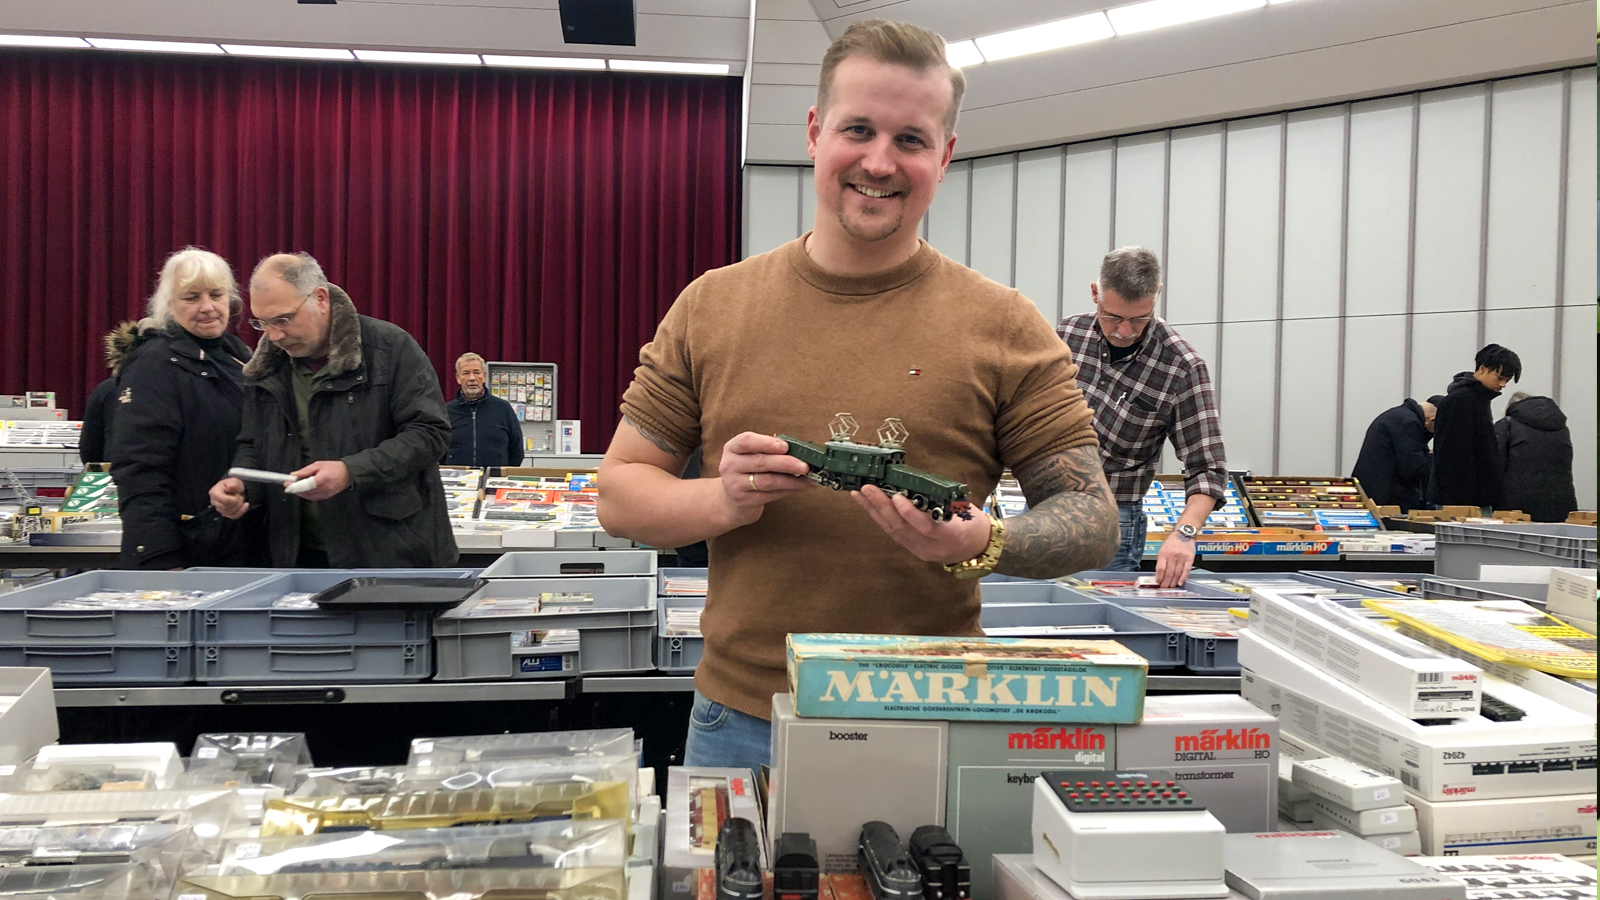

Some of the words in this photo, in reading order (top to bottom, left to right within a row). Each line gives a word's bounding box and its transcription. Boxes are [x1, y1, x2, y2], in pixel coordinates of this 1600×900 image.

[1197, 543, 1235, 552] märklin
[1276, 543, 1312, 551] märklin
[819, 669, 1122, 707] MÄRKLIN
[829, 731, 869, 741] booster
[1008, 727, 1106, 750] märklin
[1175, 728, 1270, 751] märklin
[1075, 751, 1106, 765] digital
[1175, 752, 1216, 761] DIGITAL
[1443, 752, 1466, 760] 42042
[1175, 771, 1235, 781] transformer
[1443, 786, 1476, 795] märklin
